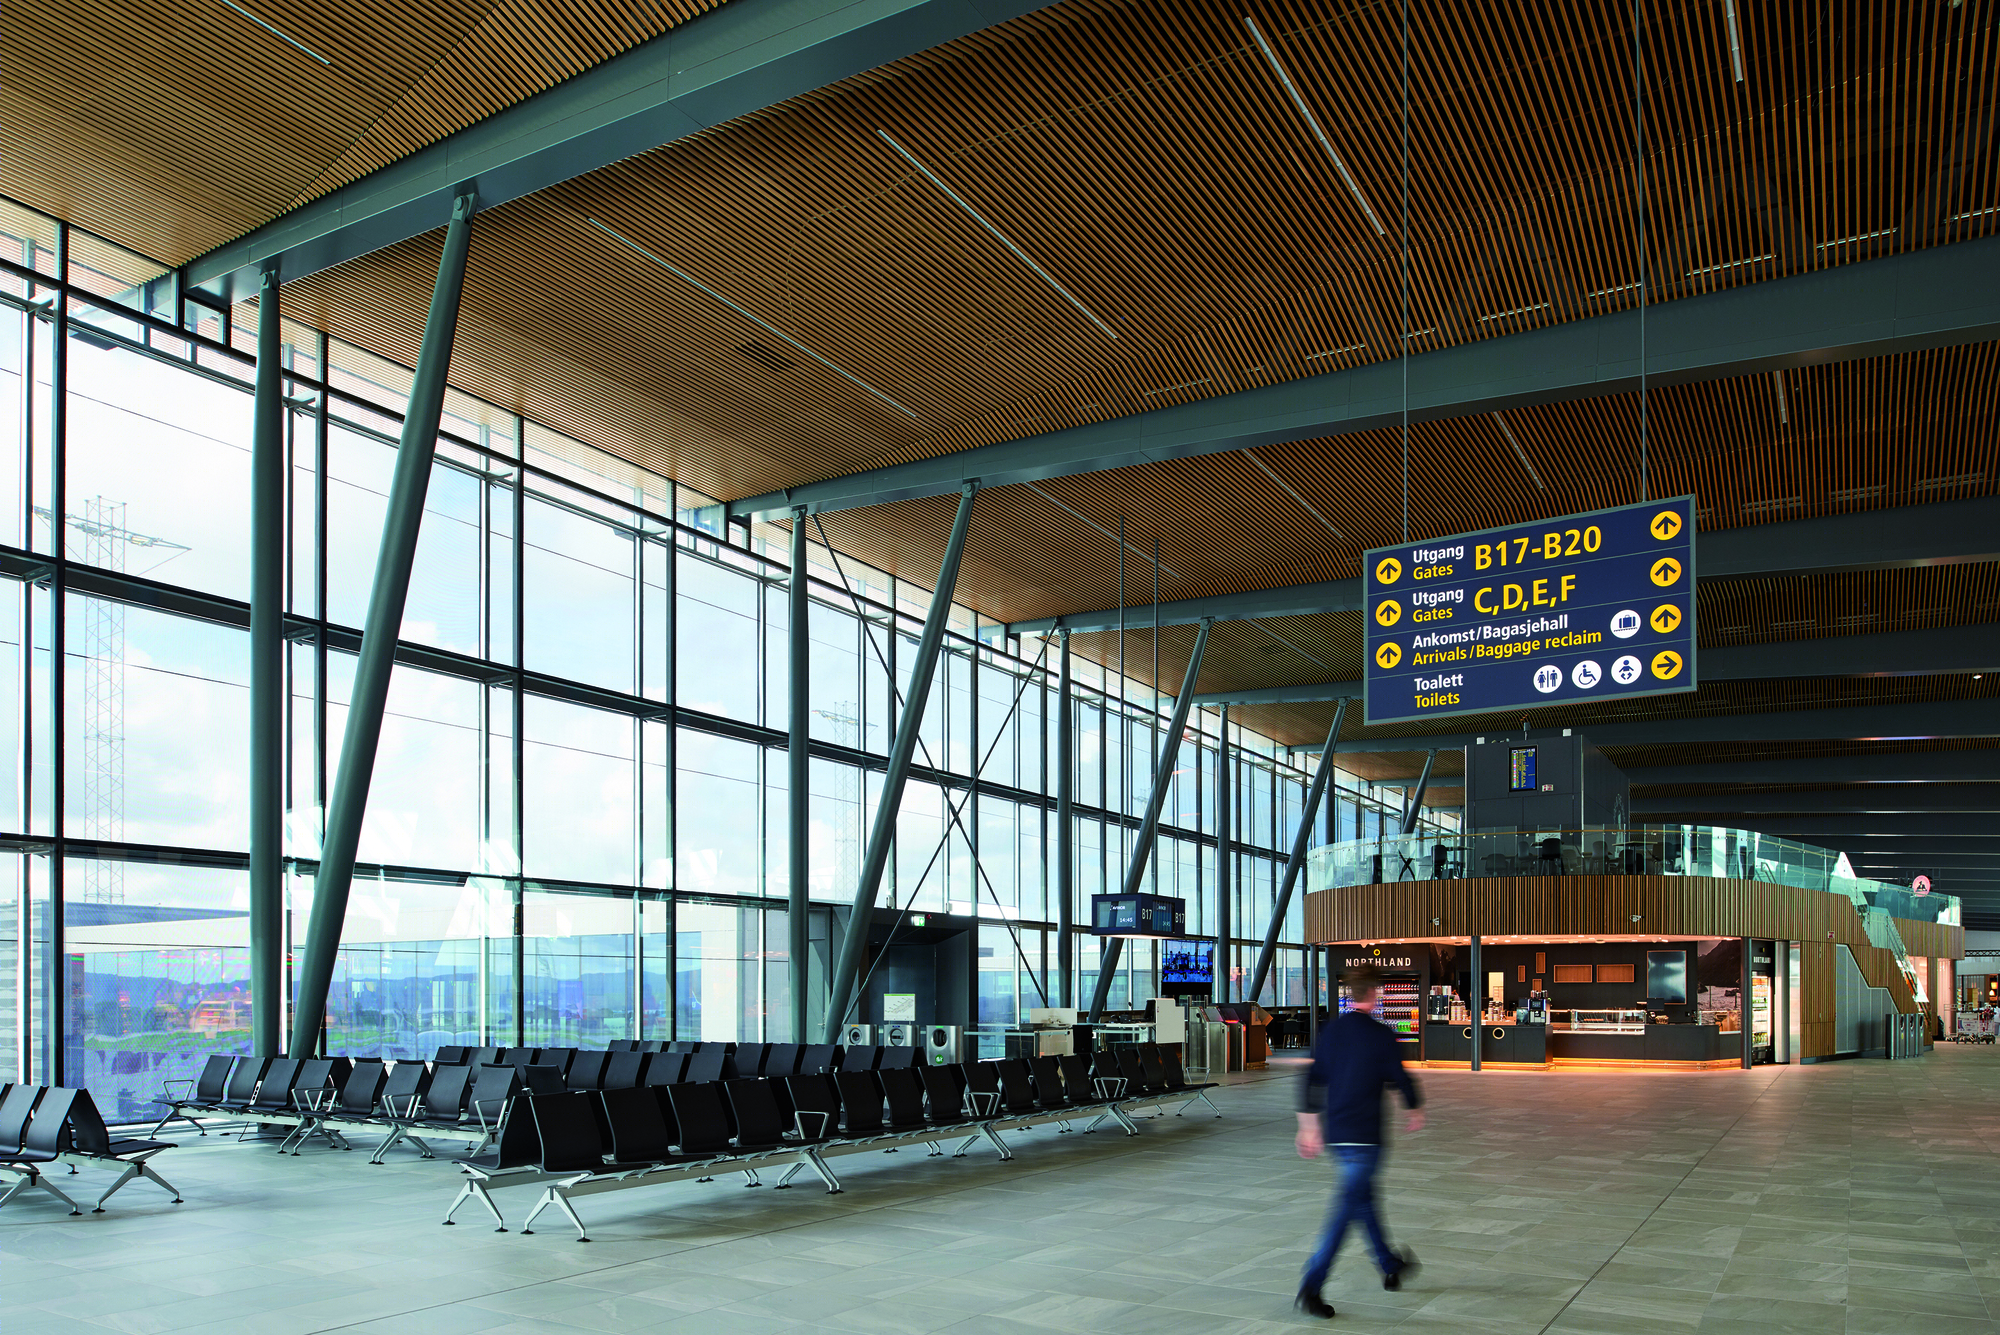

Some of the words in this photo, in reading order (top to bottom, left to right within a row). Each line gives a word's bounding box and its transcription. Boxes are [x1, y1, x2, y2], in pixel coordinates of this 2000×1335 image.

[1412, 545, 1464, 565] Utgang
[1475, 525, 1602, 571] B17-B20
[1412, 564, 1454, 580] Gates
[1412, 588, 1464, 608] Utgang
[1474, 574, 1577, 616] C,D,E,F
[1412, 607, 1454, 623] Gates
[1412, 613, 1569, 649] Ankomst/Bagasjehall
[1545, 629, 1602, 649] reclaim
[1413, 673, 1464, 692] Toalett
[1414, 691, 1461, 709] Toilets
[1141, 908, 1153, 920] B17
[1175, 912, 1185, 924] B17
[1345, 957, 1412, 967] NORTHLAND
